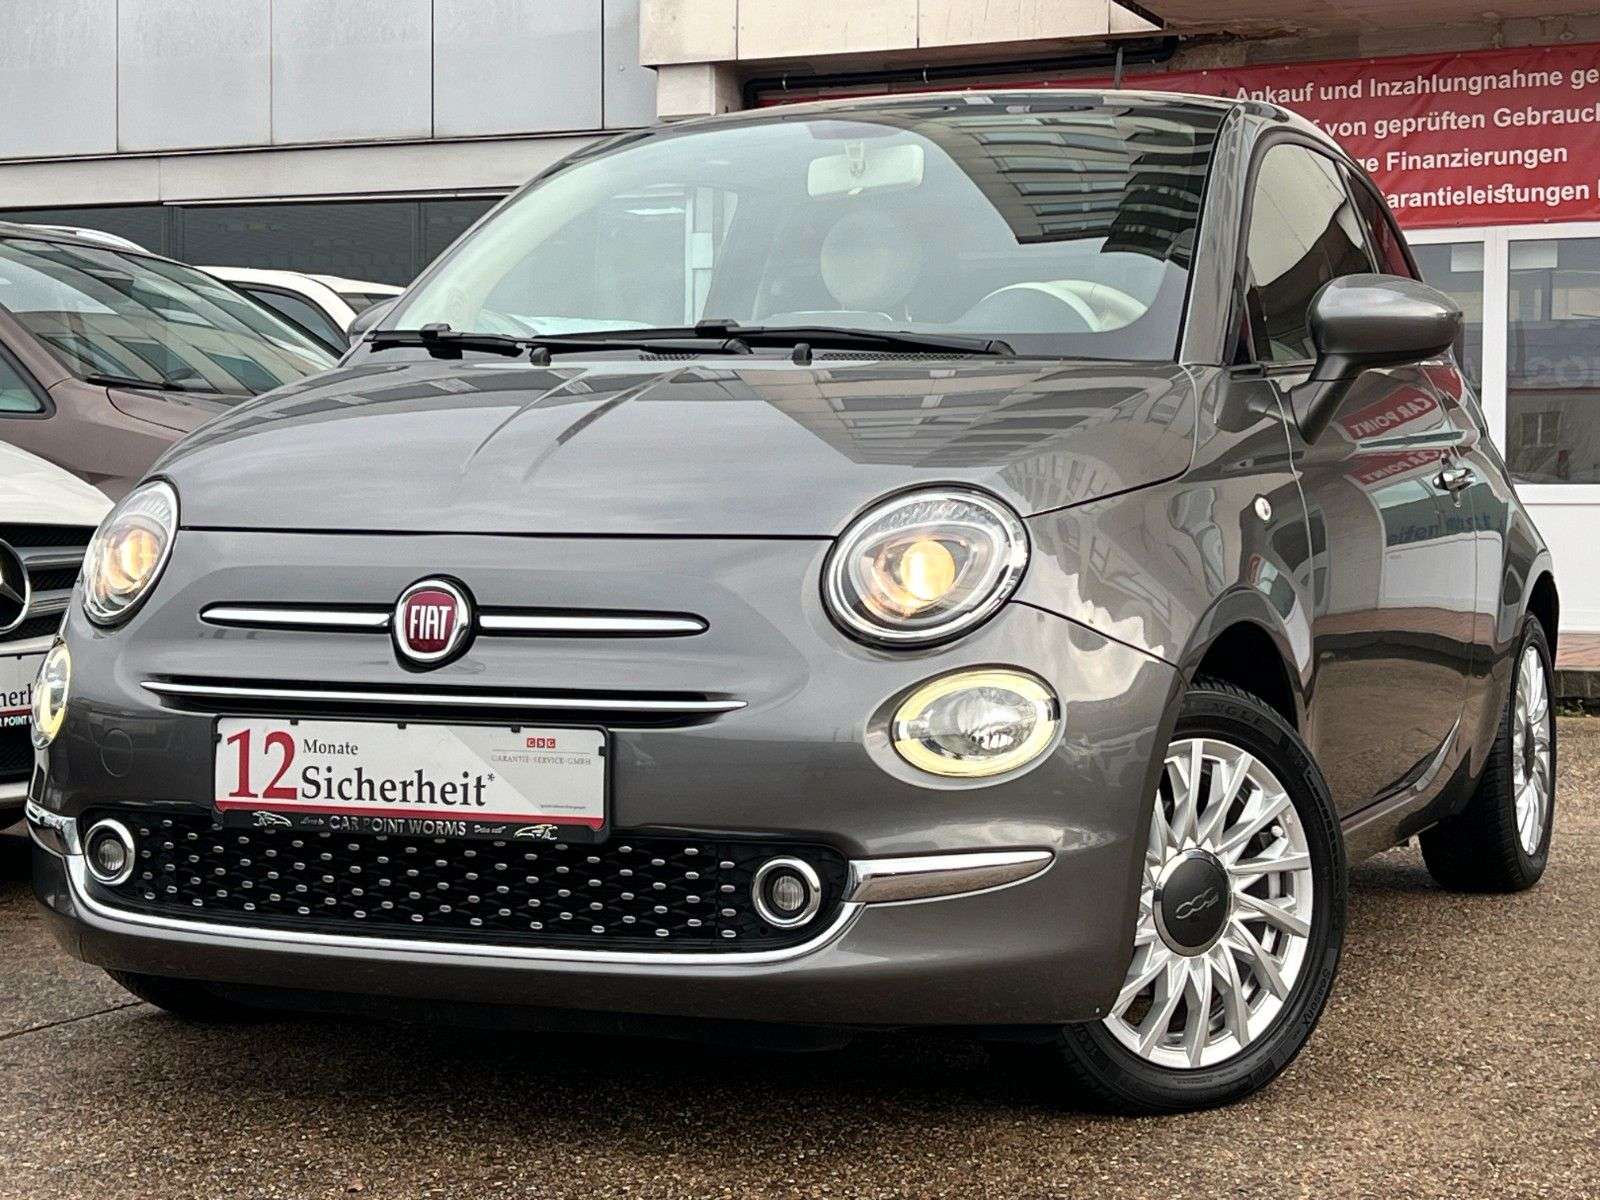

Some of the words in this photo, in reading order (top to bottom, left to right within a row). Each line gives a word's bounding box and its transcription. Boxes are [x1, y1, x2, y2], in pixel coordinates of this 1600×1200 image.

[1235, 82, 1314, 103] Ankauf
[1320, 79, 1362, 101] und
[1370, 68, 1562, 98] Inzahlungnahme
[1325, 120, 1367, 137] von
[1374, 111, 1486, 139] geprüften
[1493, 105, 1600, 128] Gebrauc
[1386, 147, 1568, 172] Finanzierungen
[1380, 183, 1590, 208] arantieleistungen
[409, 605, 452, 640] FIAT
[302, 738, 359, 756] Monate
[226, 729, 298, 800] 12
[329, 815, 360, 830] CAR
[363, 817, 405, 833] POINT
[408, 819, 467, 836] WORMS
